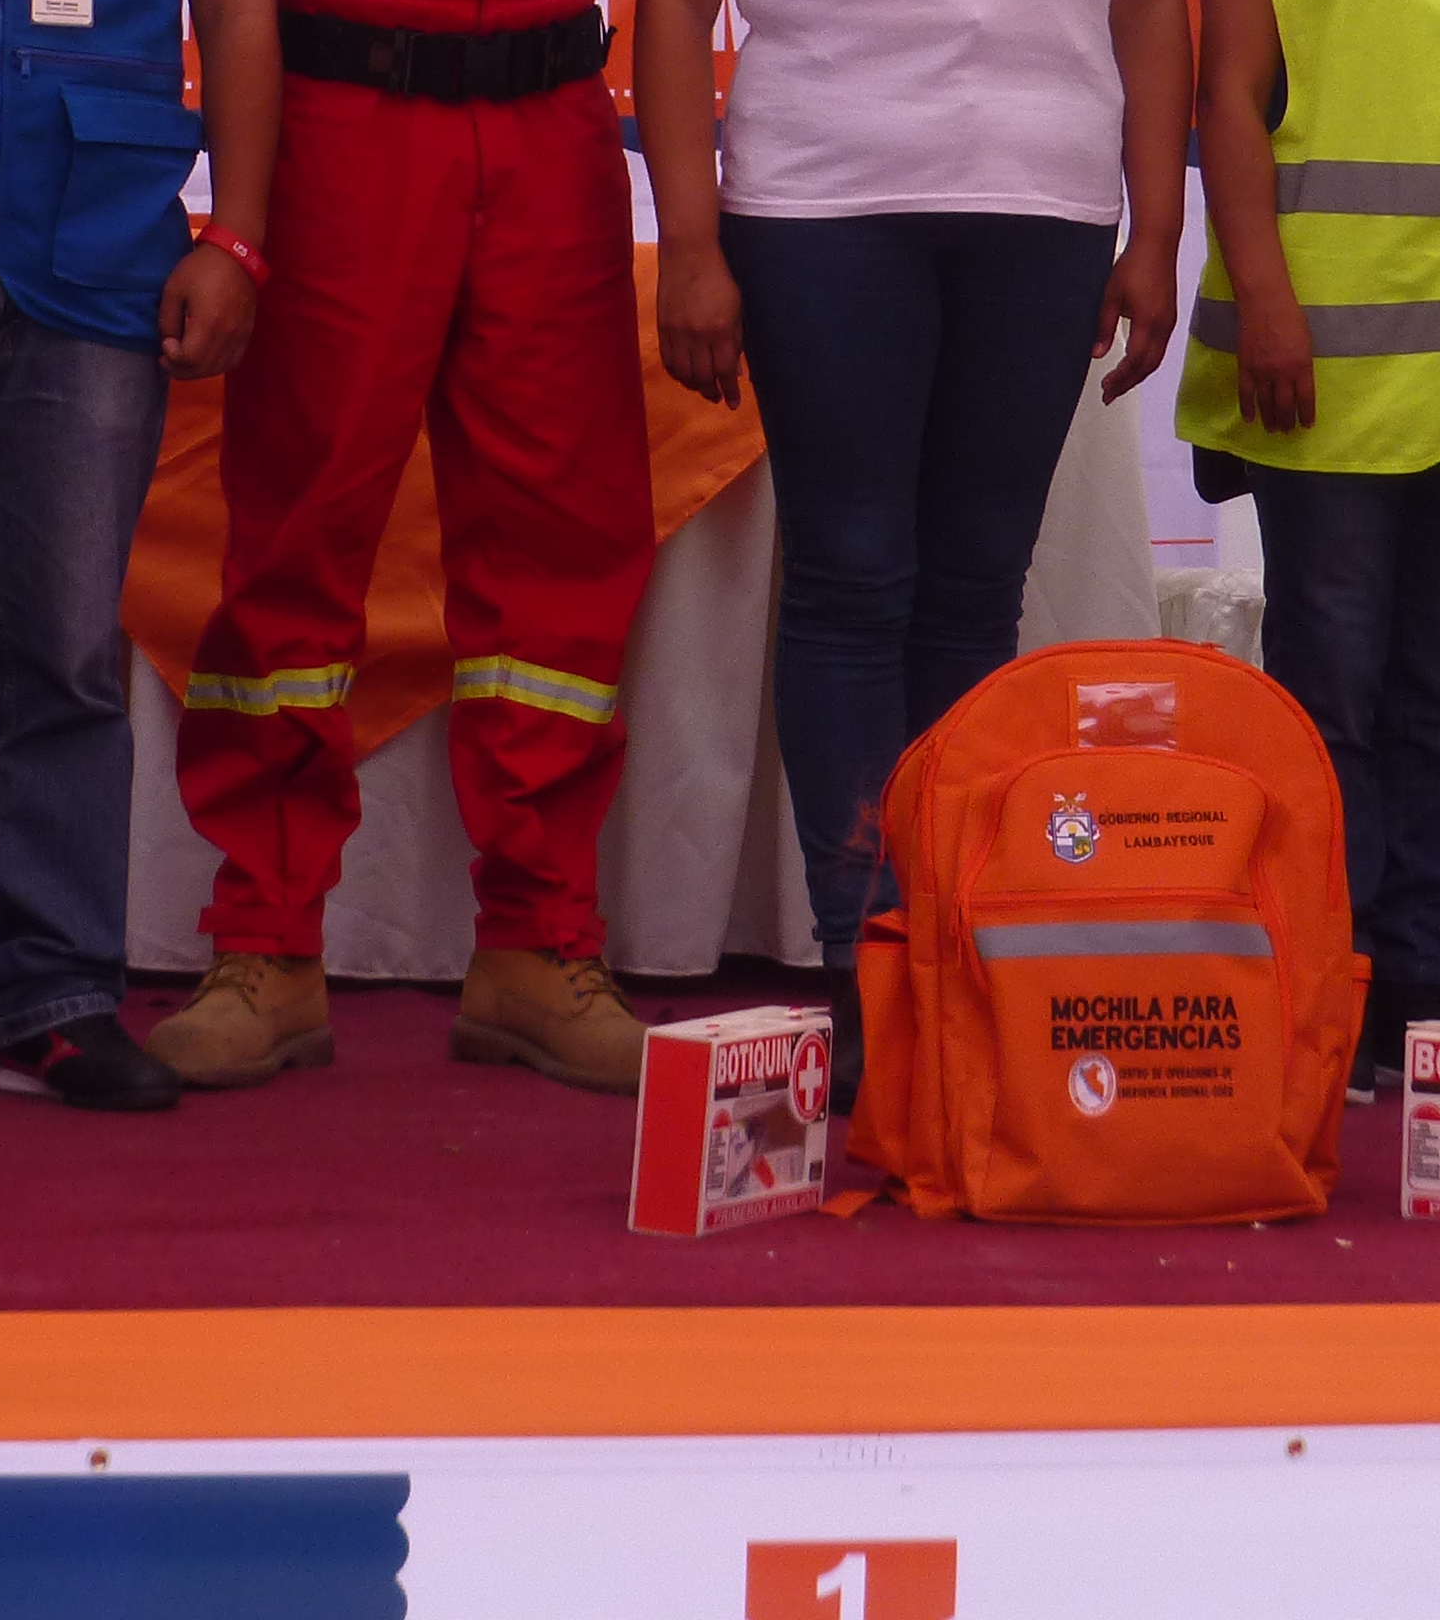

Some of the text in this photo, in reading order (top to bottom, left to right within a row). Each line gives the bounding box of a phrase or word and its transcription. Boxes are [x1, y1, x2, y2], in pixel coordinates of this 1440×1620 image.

[1098, 810, 1228, 826] GOBIERNO REGIONAL
[1123, 834, 1215, 849] LAMBAYEQUE
[1051, 995, 1238, 1022] MOCHILA PARA
[1051, 1024, 1242, 1051] EMERGENCIAS
[717, 1036, 793, 1085] BOTIQUIN
[817, 1554, 866, 1620] 1
